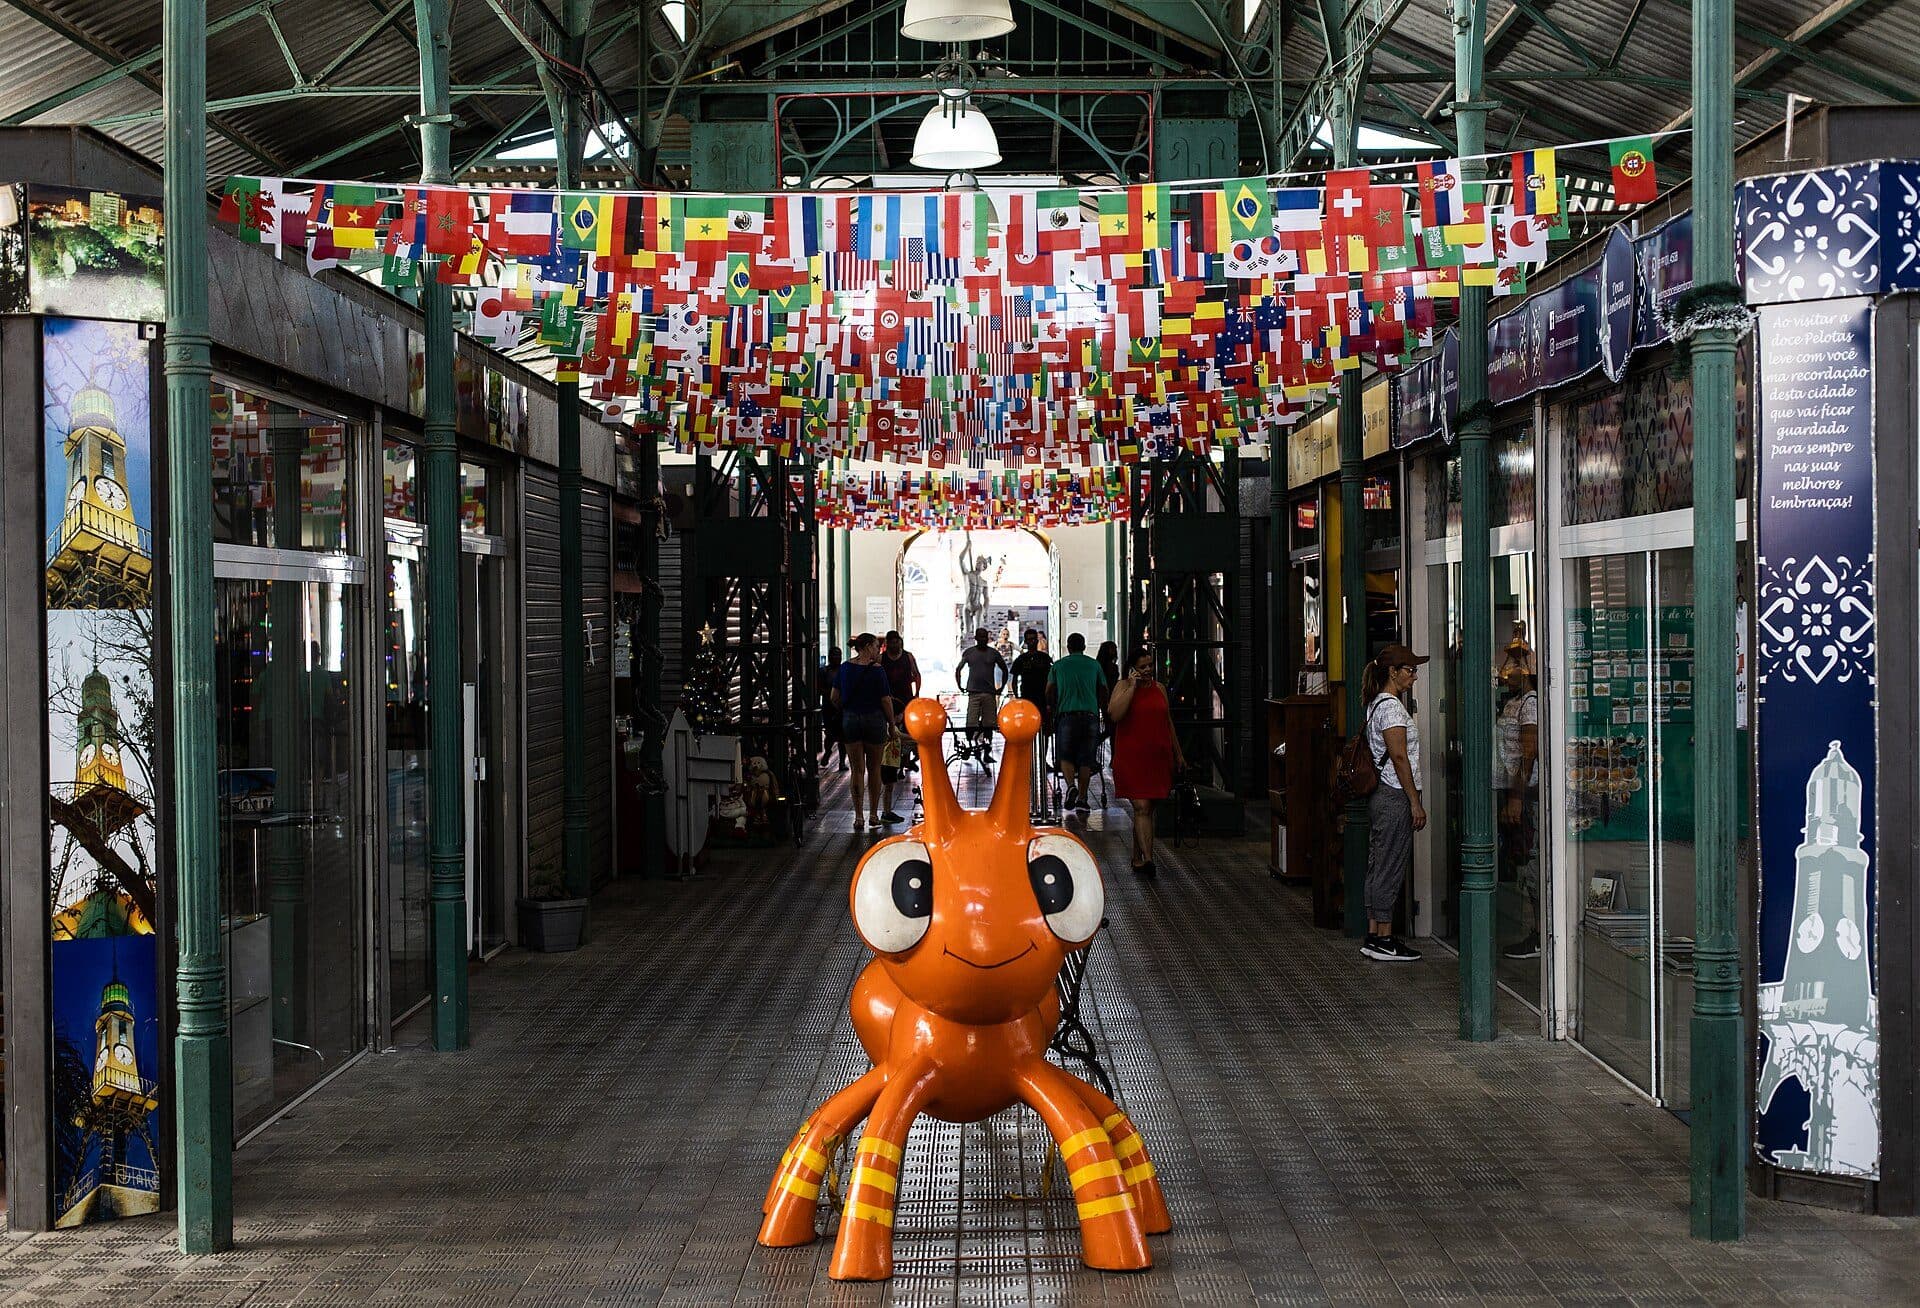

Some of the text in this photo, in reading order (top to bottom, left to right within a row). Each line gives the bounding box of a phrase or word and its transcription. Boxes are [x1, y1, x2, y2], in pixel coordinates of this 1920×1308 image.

[1773, 312, 1852, 328] Ao visitar a
[1771, 329, 1855, 346] doce Pelotas
[1796, 351, 1826, 363] com
[1791, 366, 1870, 382] recordação
[1769, 383, 1857, 401] desta cidade
[1770, 402, 1855, 423] que vai ficar
[1776, 420, 1849, 440] guardada
[1771, 442, 1855, 459] para sempre
[1784, 461, 1842, 472] nas suas
[1782, 476, 1843, 490] melhores
[1770, 494, 1853, 510] lembranças!
